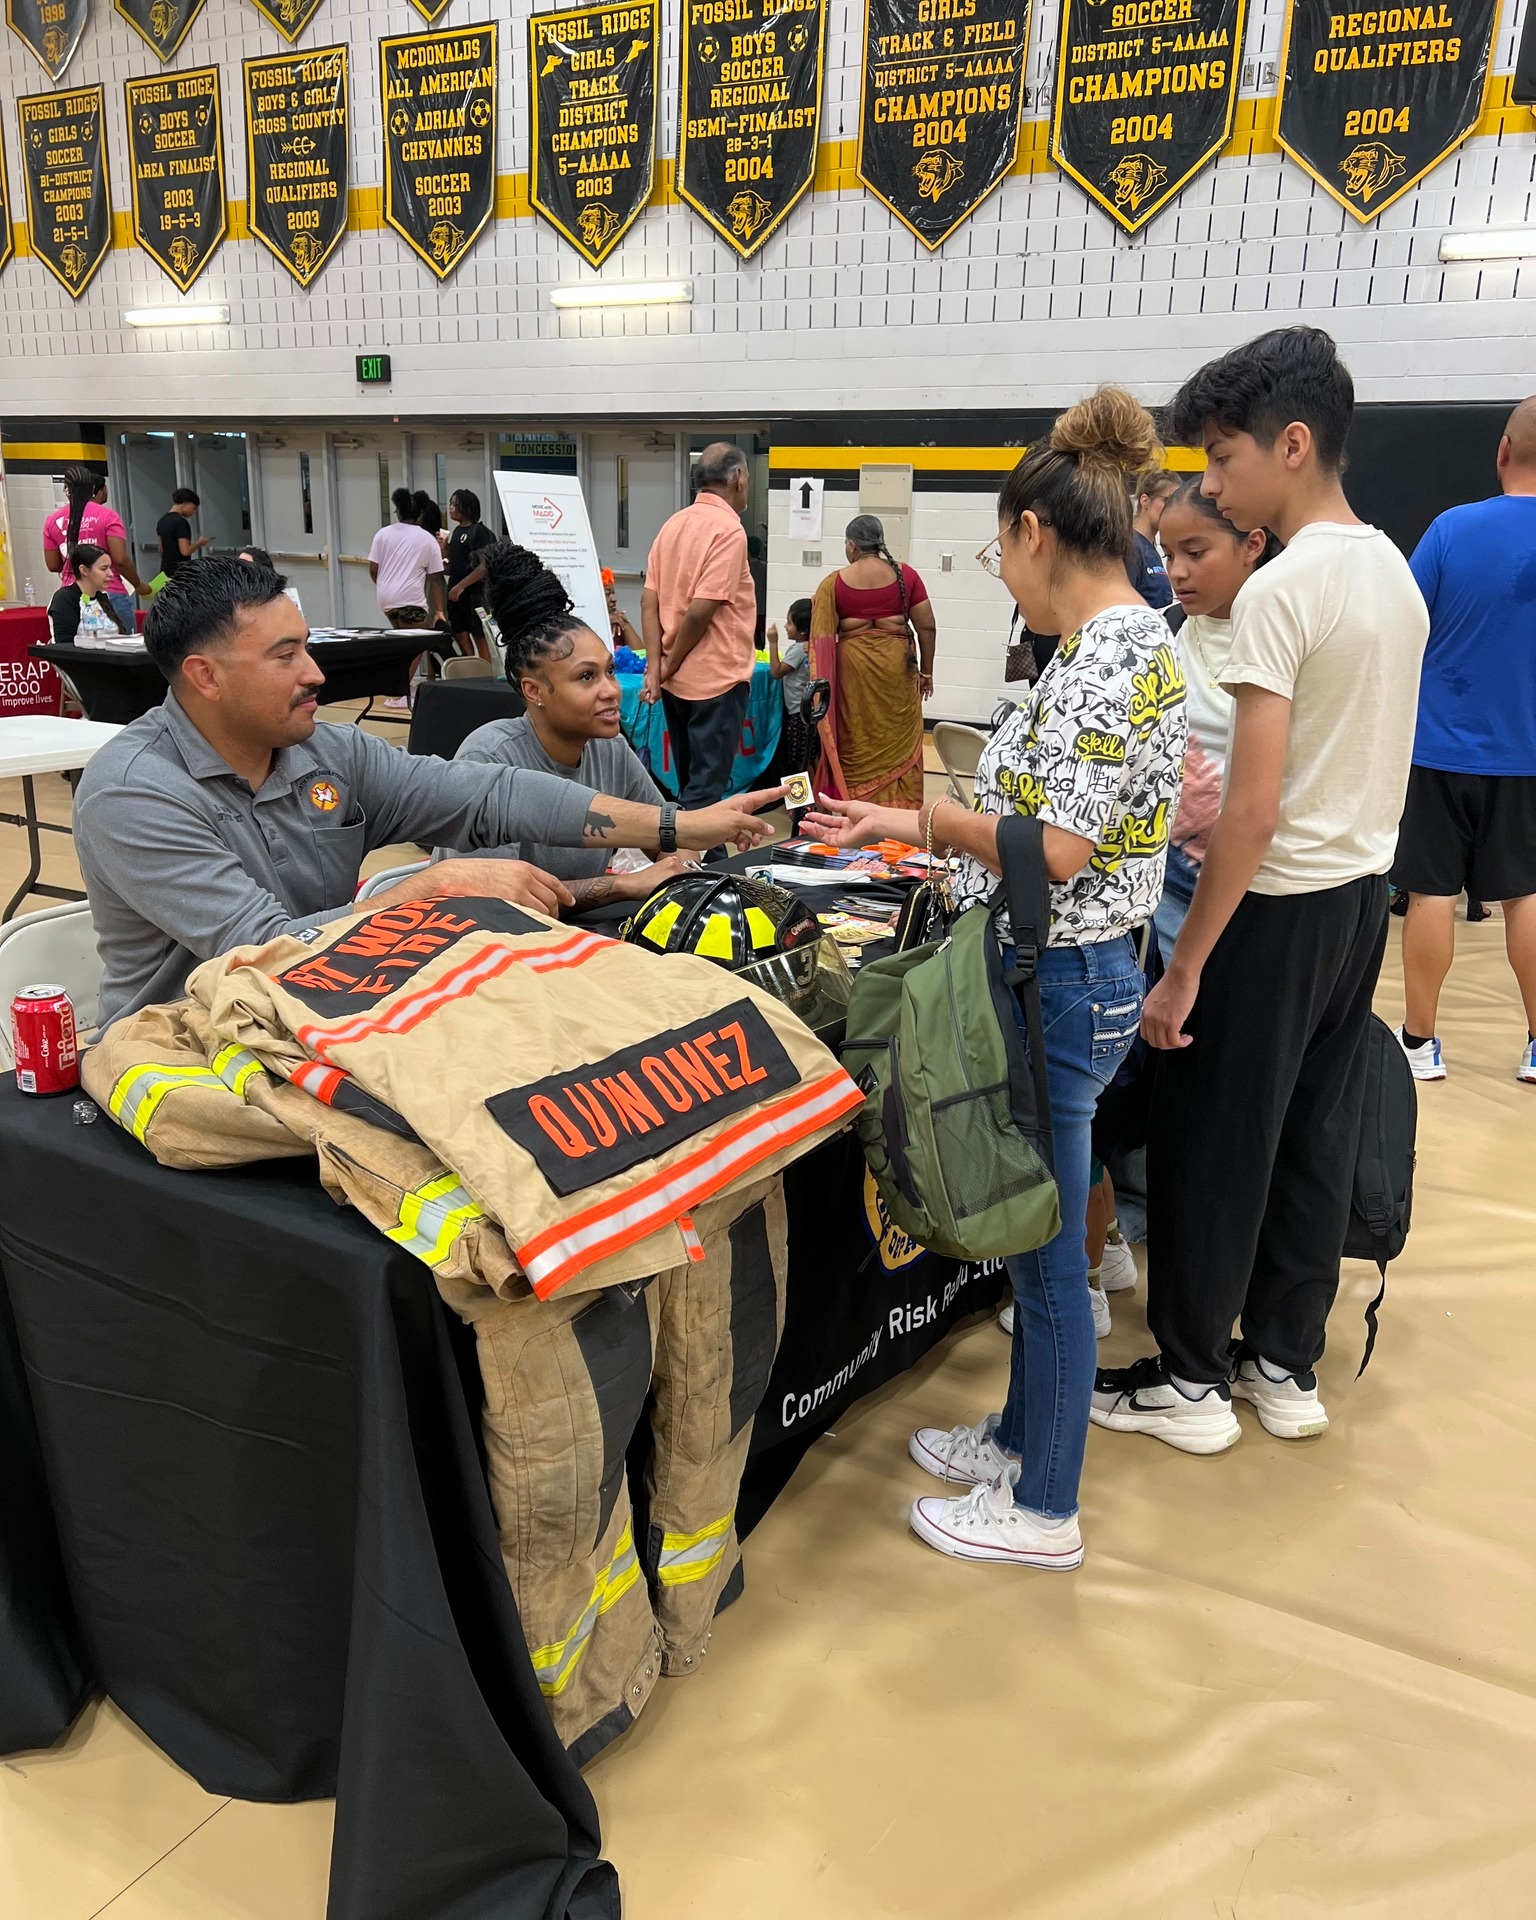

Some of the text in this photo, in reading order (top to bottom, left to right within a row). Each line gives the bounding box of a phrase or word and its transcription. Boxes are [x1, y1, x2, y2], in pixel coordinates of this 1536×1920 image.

[41, 4, 66, 24] 1998
[691, 0, 817, 26] FOSSIL RIDGE
[918, 0, 976, 23] GIRLS
[1111, 0, 1192, 27] SOCCER
[1329, 4, 1453, 39] REGIONAL
[538, 7, 650, 46] FOSSIL RIDGE
[878, 30, 935, 56] TRACK
[963, 19, 1016, 45] FIELD
[397, 38, 480, 70] MCDONALDS
[730, 31, 776, 58] BOYS
[1071, 28, 1229, 64] DISTRICT 5-AAAAA
[1314, 37, 1462, 74] QUALIFIERS
[570, 46, 615, 72] GIRLS
[720, 55, 784, 82] SOCCER
[875, 56, 1015, 88] DISTRICT 5-AAAAA
[251, 59, 341, 89] FOSSIL RIDGE
[387, 66, 493, 100] ALL AMERICAN
[568, 74, 620, 100] TRACK
[1069, 60, 1226, 104] CHAMPIONS
[132, 77, 214, 105] FOSSIL RIDGE
[257, 93, 286, 112] BOYS
[304, 85, 338, 105] GIRLS
[710, 81, 790, 109] REGIONAL
[874, 83, 1012, 124] CHAMPIONS
[25, 95, 99, 122] FOSSIL RIDGE
[159, 110, 189, 131] BOYS
[253, 108, 345, 135] CROSS COUNTRY
[414, 107, 466, 132] ADRIAN
[559, 99, 628, 128] DISTRICT
[1344, 106, 1410, 137] 2004
[48, 125, 77, 143] GIRLS
[687, 107, 816, 139] SEMI-FINALIST
[913, 118, 967, 148] 2004
[1110, 112, 1173, 145] 2004
[154, 130, 196, 150] SOCCER
[401, 134, 482, 162] CHEVANNES
[551, 123, 639, 153] CHAMPIONS
[46, 147, 83, 165] SOCCER
[138, 156, 216, 179] AREA FINALIST
[269, 158, 329, 180] REGIONAL
[558, 149, 632, 176] 5-AAAAA
[725, 155, 774, 183] 2004
[40, 169, 93, 187] BI-DISTRICT
[415, 172, 471, 196] SOCCER
[575, 176, 613, 198] 2003
[43, 186, 92, 203] CHAMPIONS
[164, 188, 194, 209] 2003
[266, 181, 337, 204] QUALIFIERS
[428, 195, 462, 217] 2003
[55, 204, 84, 222] 2003
[159, 212, 201, 230] 19-5-3
[287, 210, 320, 230] 2003
[53, 225, 89, 243] 21-5-1
[362, 357, 382, 379] EXIT
[0, 660, 59, 681] ERAP
[0, 680, 40, 697] 2000
[2, 696, 34, 708] improve
[1075, 731, 1124, 758] Skills
[347, 911, 478, 994] FIRE
[53, 999, 77, 1071] Friend
[781, 1255, 1005, 1428] Community Risk Redutio
